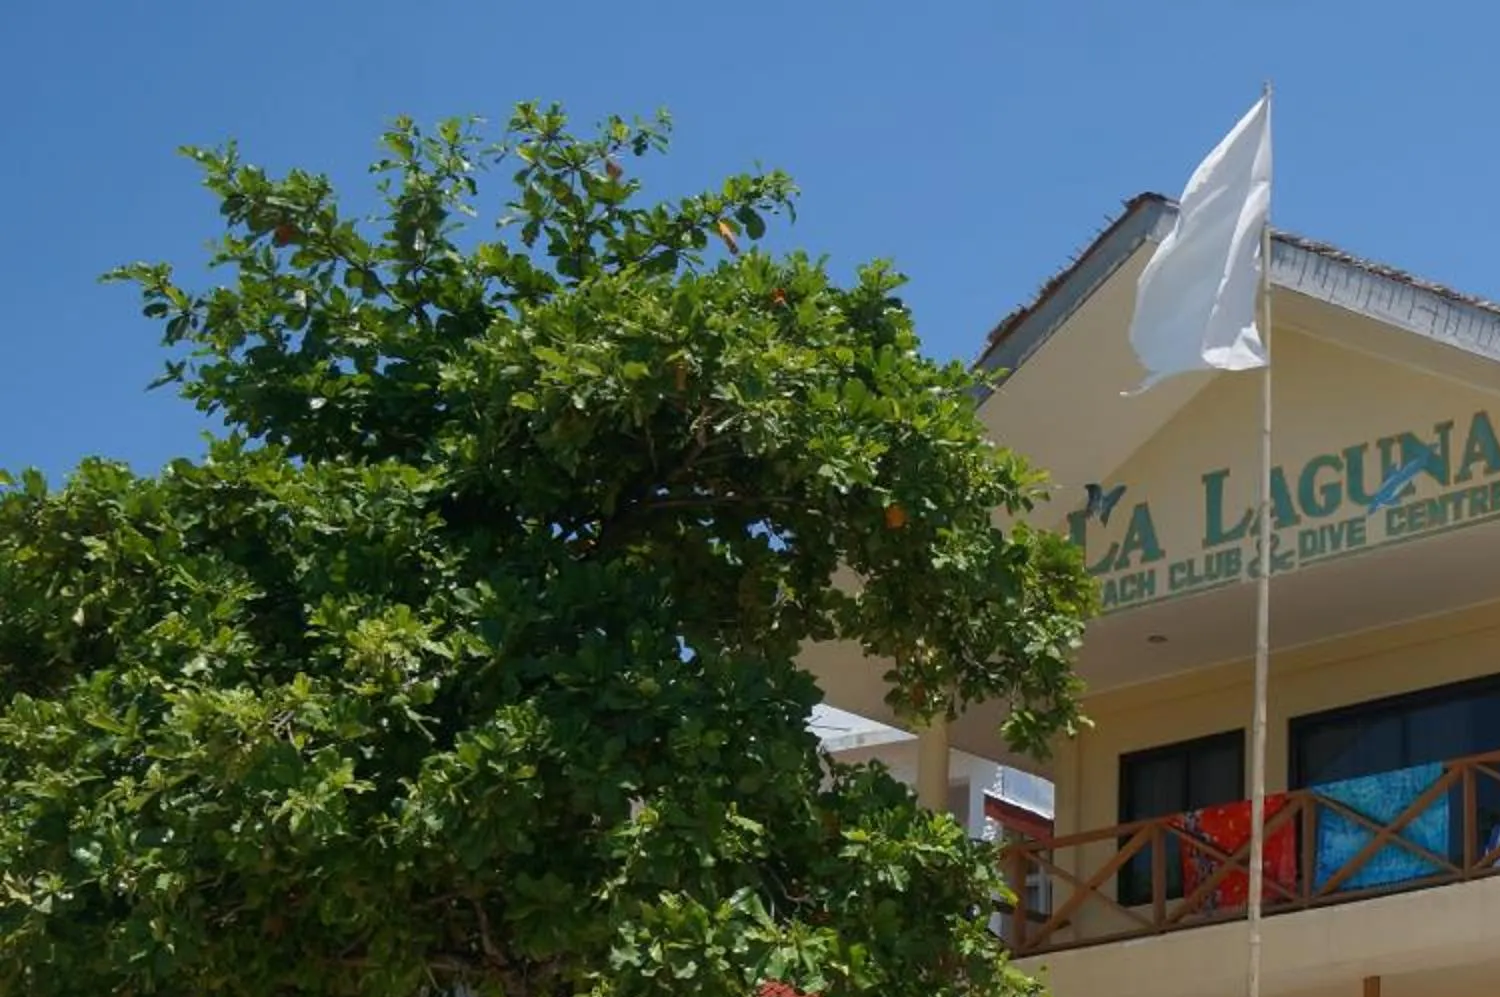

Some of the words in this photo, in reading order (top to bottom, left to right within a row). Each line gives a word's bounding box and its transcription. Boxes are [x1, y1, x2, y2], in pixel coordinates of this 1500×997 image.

[1067, 501, 1166, 576] LA
[1168, 548, 1242, 592] CLUB
[1246, 533, 1296, 580] &
[1300, 517, 1367, 557] DIVE
